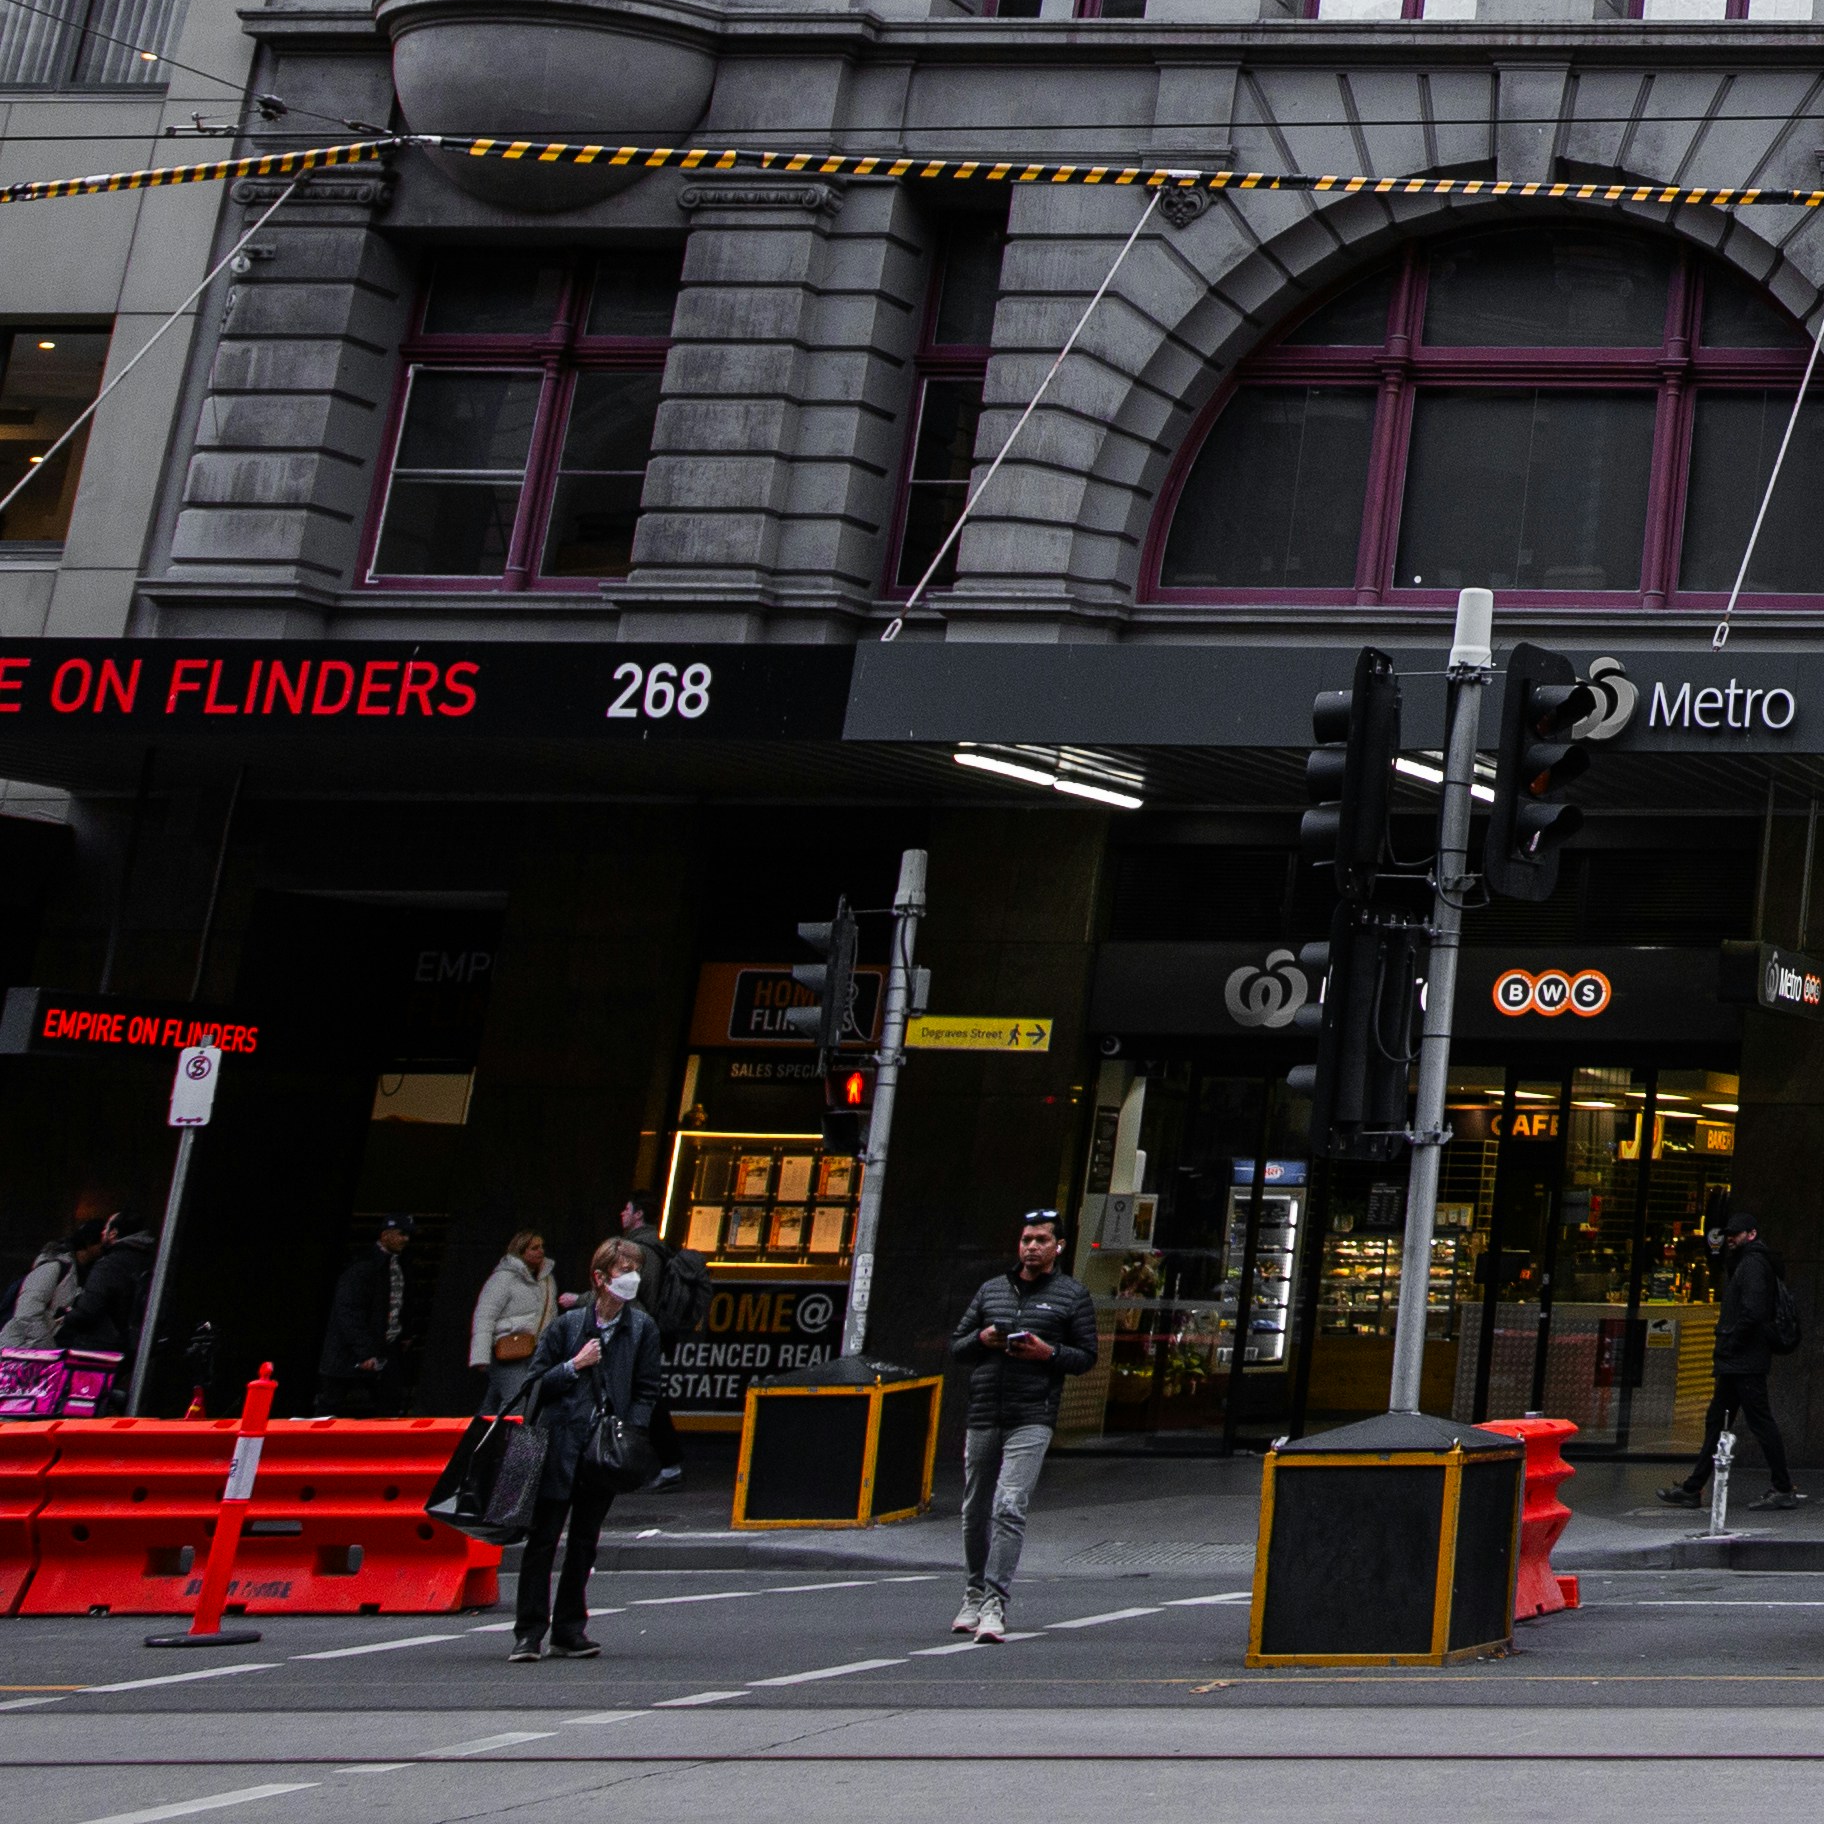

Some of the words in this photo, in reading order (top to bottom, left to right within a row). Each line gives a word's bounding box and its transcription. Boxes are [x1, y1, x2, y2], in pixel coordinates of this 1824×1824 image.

[50, 659, 142, 714] ON
[165, 660, 480, 716] FLINDERS
[607, 663, 713, 718] 268
[1649, 679, 1795, 729] Metro
[1779, 967, 1803, 1002] Metro
[43, 1007, 126, 1043] EMPIRE
[127, 1016, 159, 1046] ON
[161, 1019, 260, 1054] FLINDERS
[921, 1027, 968, 1039] Degraves
[970, 1028, 1003, 1039] Street
[730, 1062, 771, 1077] SALES
[694, 1292, 834, 1334] OME@
[660, 1374, 741, 1398] ESTATE
